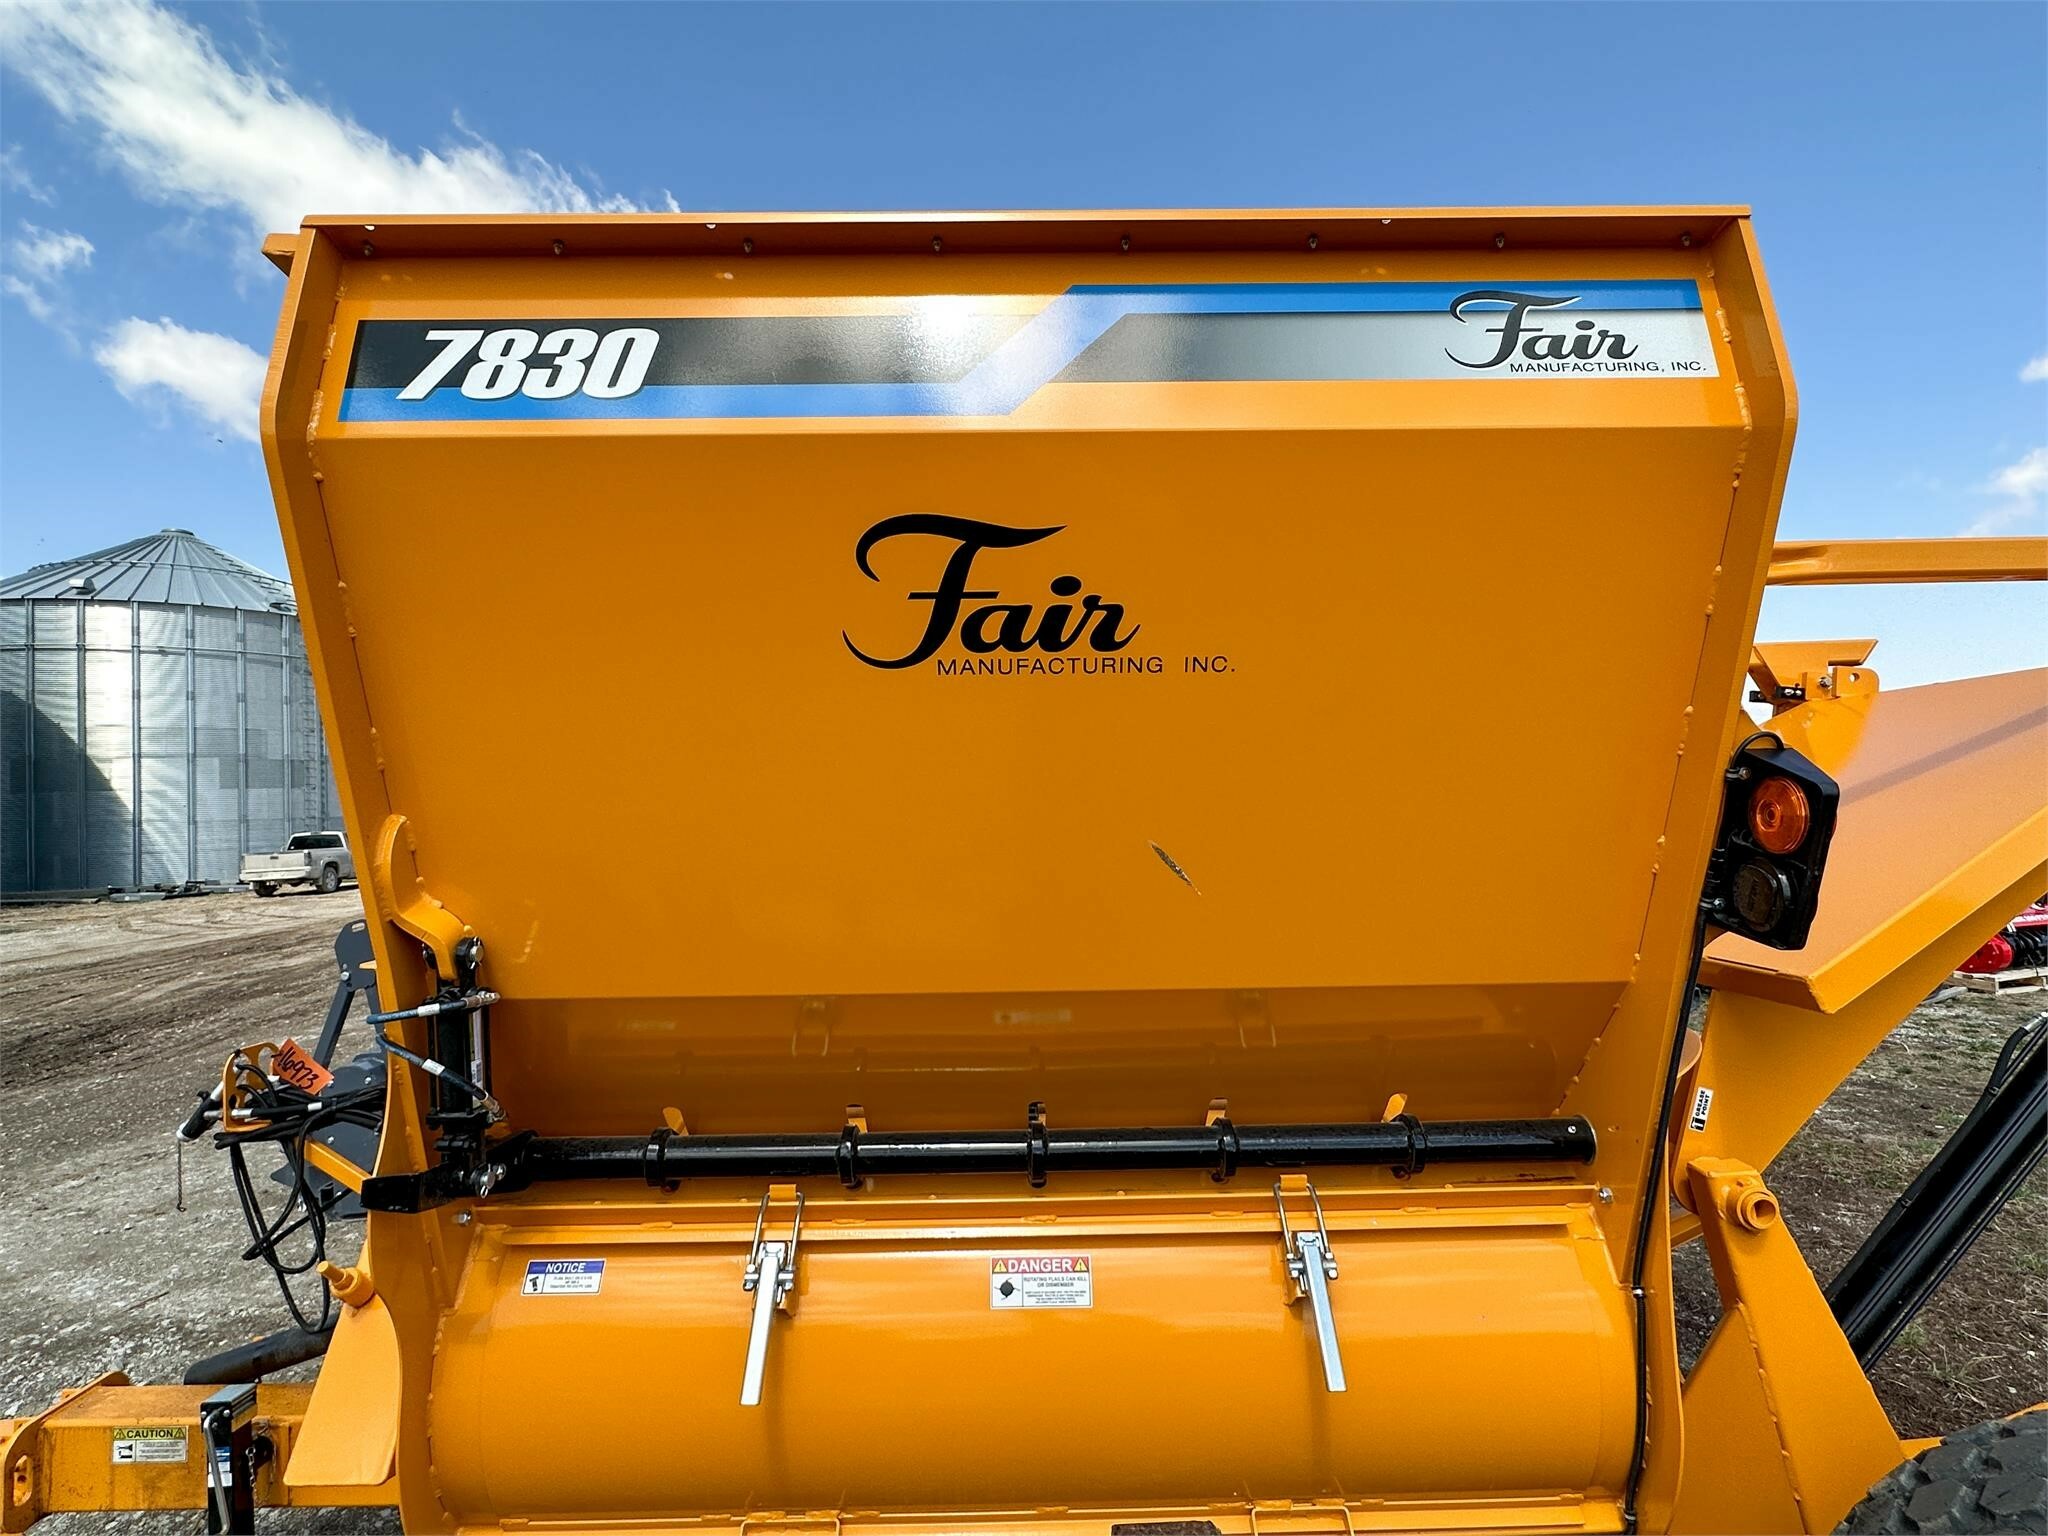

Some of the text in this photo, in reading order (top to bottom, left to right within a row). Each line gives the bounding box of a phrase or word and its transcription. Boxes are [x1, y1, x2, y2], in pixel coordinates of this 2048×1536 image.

[1445, 290, 1639, 369] Fair
[395, 327, 660, 400] 7830
[1510, 361, 1707, 373] MANUFACTURING, INC.
[842, 513, 1141, 669] Fair
[937, 655, 1236, 676] MANUFACTURING INC.
[1701, 1094, 1710, 1116] POINT
[546, 1262, 587, 1273] NOTICE
[1007, 1258, 1073, 1273] DANGER
[126, 1429, 173, 1439] CAUTION
